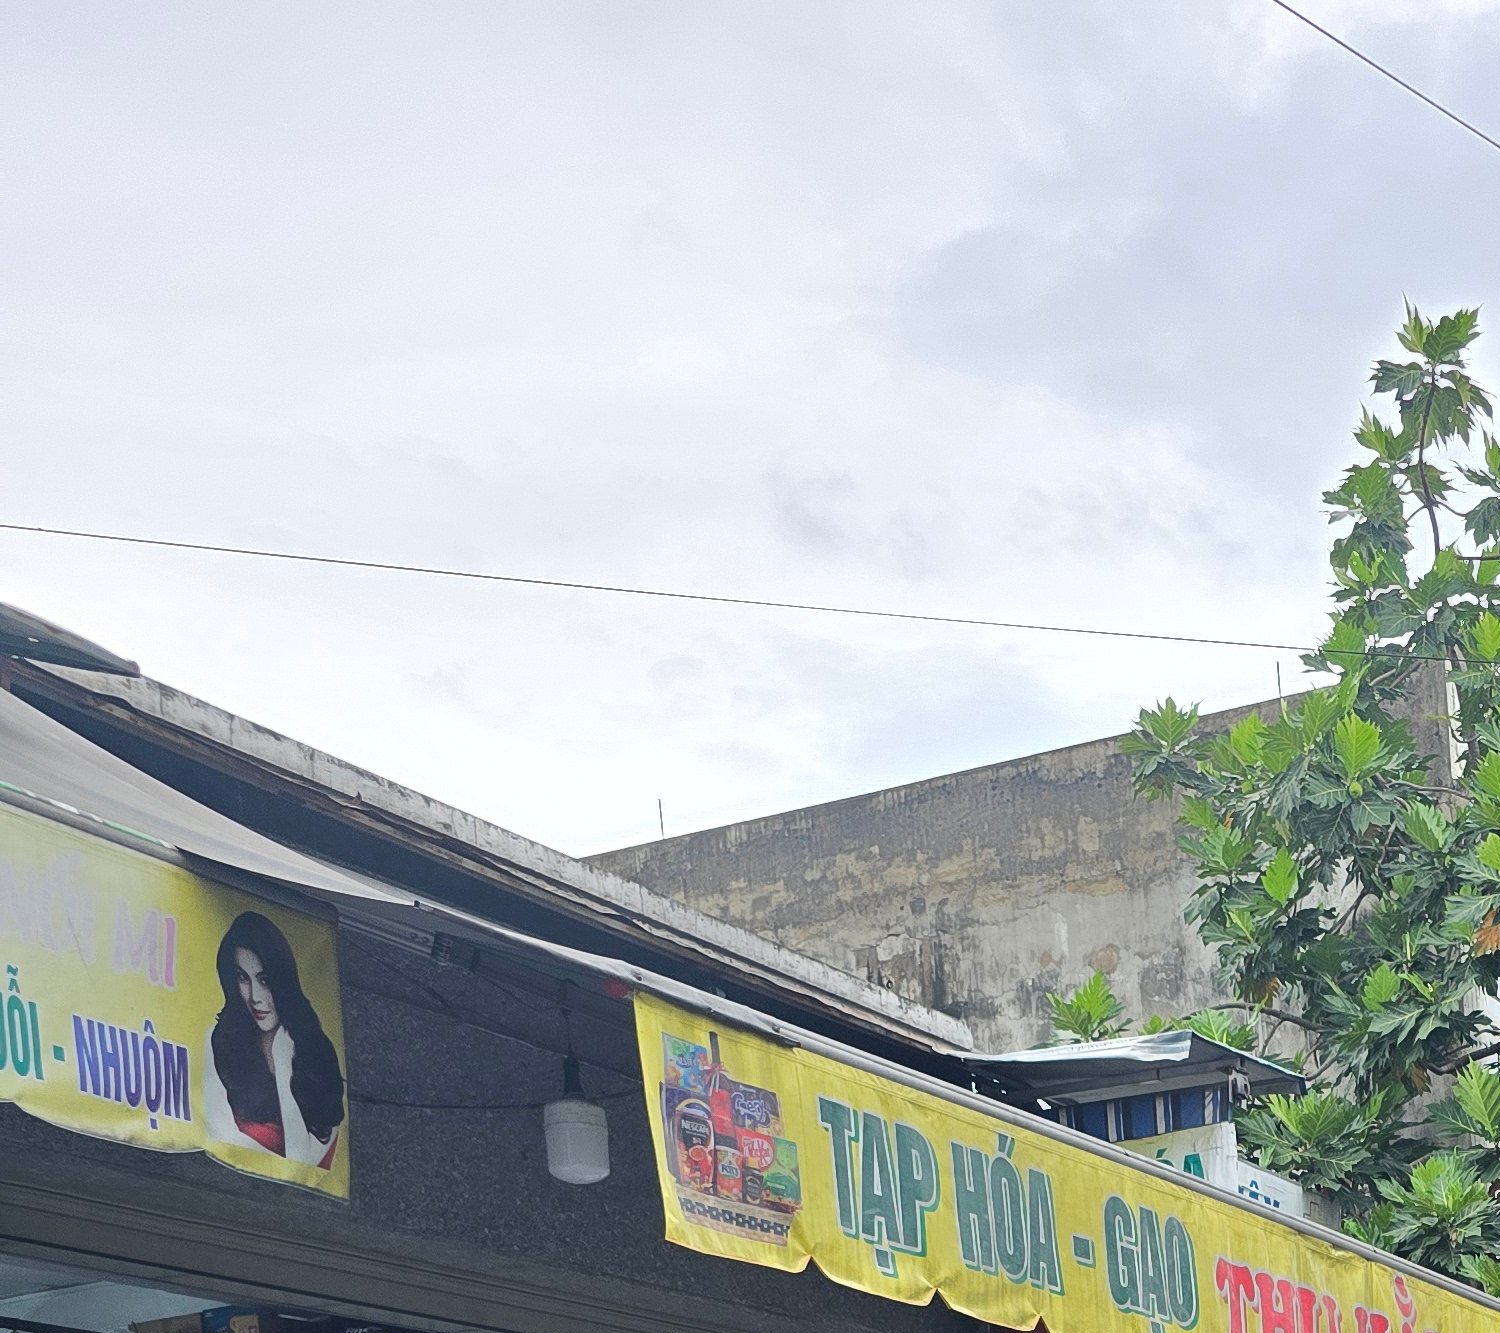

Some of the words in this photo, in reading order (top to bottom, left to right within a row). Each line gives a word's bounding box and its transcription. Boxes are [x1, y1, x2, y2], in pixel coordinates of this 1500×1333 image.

[0, 964, 44, 1080] ỖI
[72, 1015, 191, 1130] NHUỘM
[817, 1096, 940, 1278] TẠP
[950, 1131, 1064, 1296] HÓA
